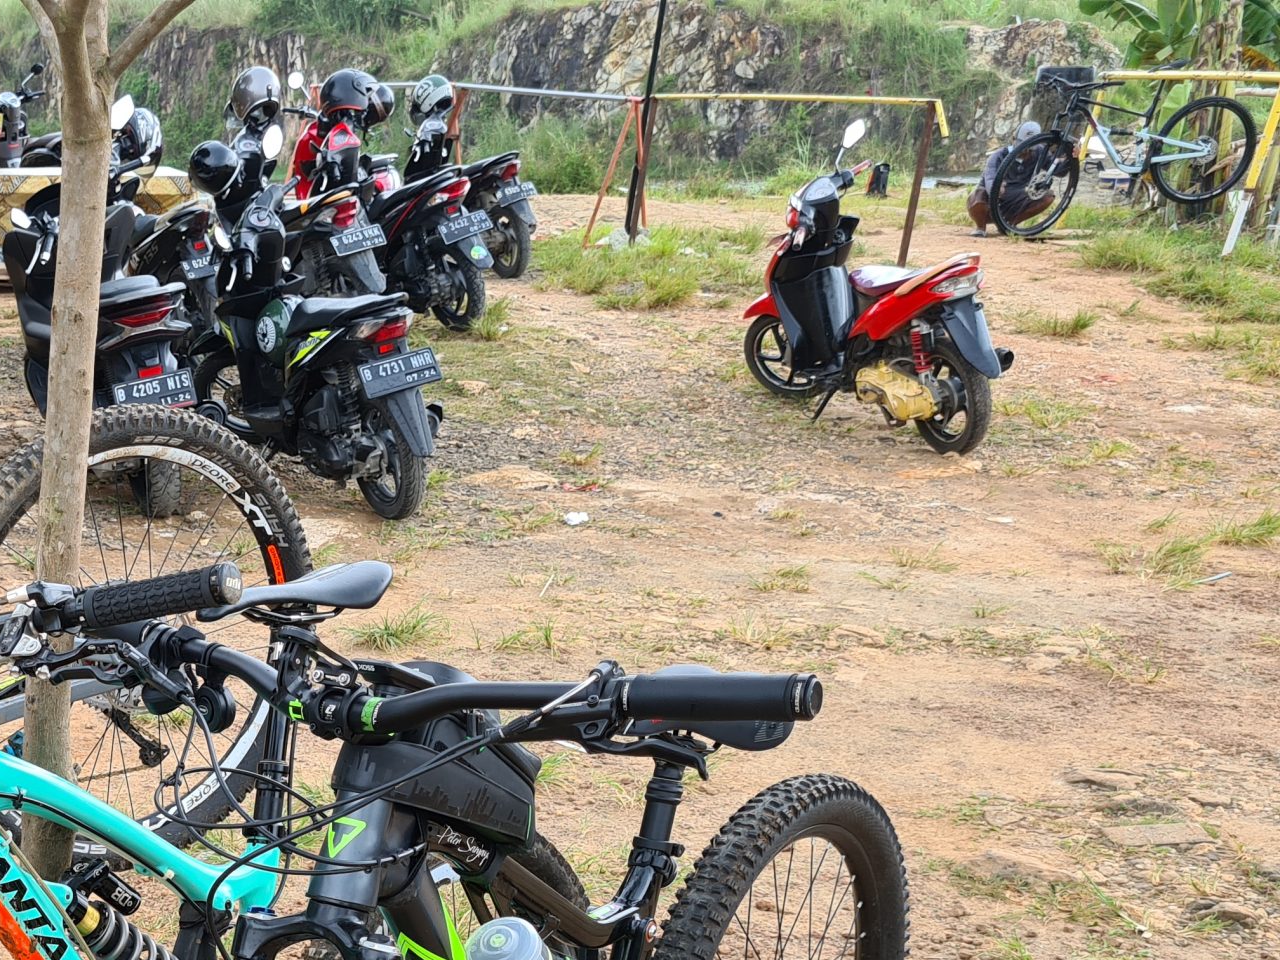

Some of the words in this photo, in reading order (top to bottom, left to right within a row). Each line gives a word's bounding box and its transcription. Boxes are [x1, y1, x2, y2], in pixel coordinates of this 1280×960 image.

[331, 238, 339, 247] B
[342, 231, 363, 245] 6243
[182, 261, 190, 271] B
[363, 368, 373, 383] B
[379, 359, 406, 377] 4731
[410, 351, 434, 370] NHR
[117, 388, 127, 402] B
[132, 380, 161, 399] 4205
[166, 373, 190, 391] NIS
[191, 457, 237, 492] DEORE
[231, 491, 274, 537] XT
[357, 663, 375, 672] XOSS
